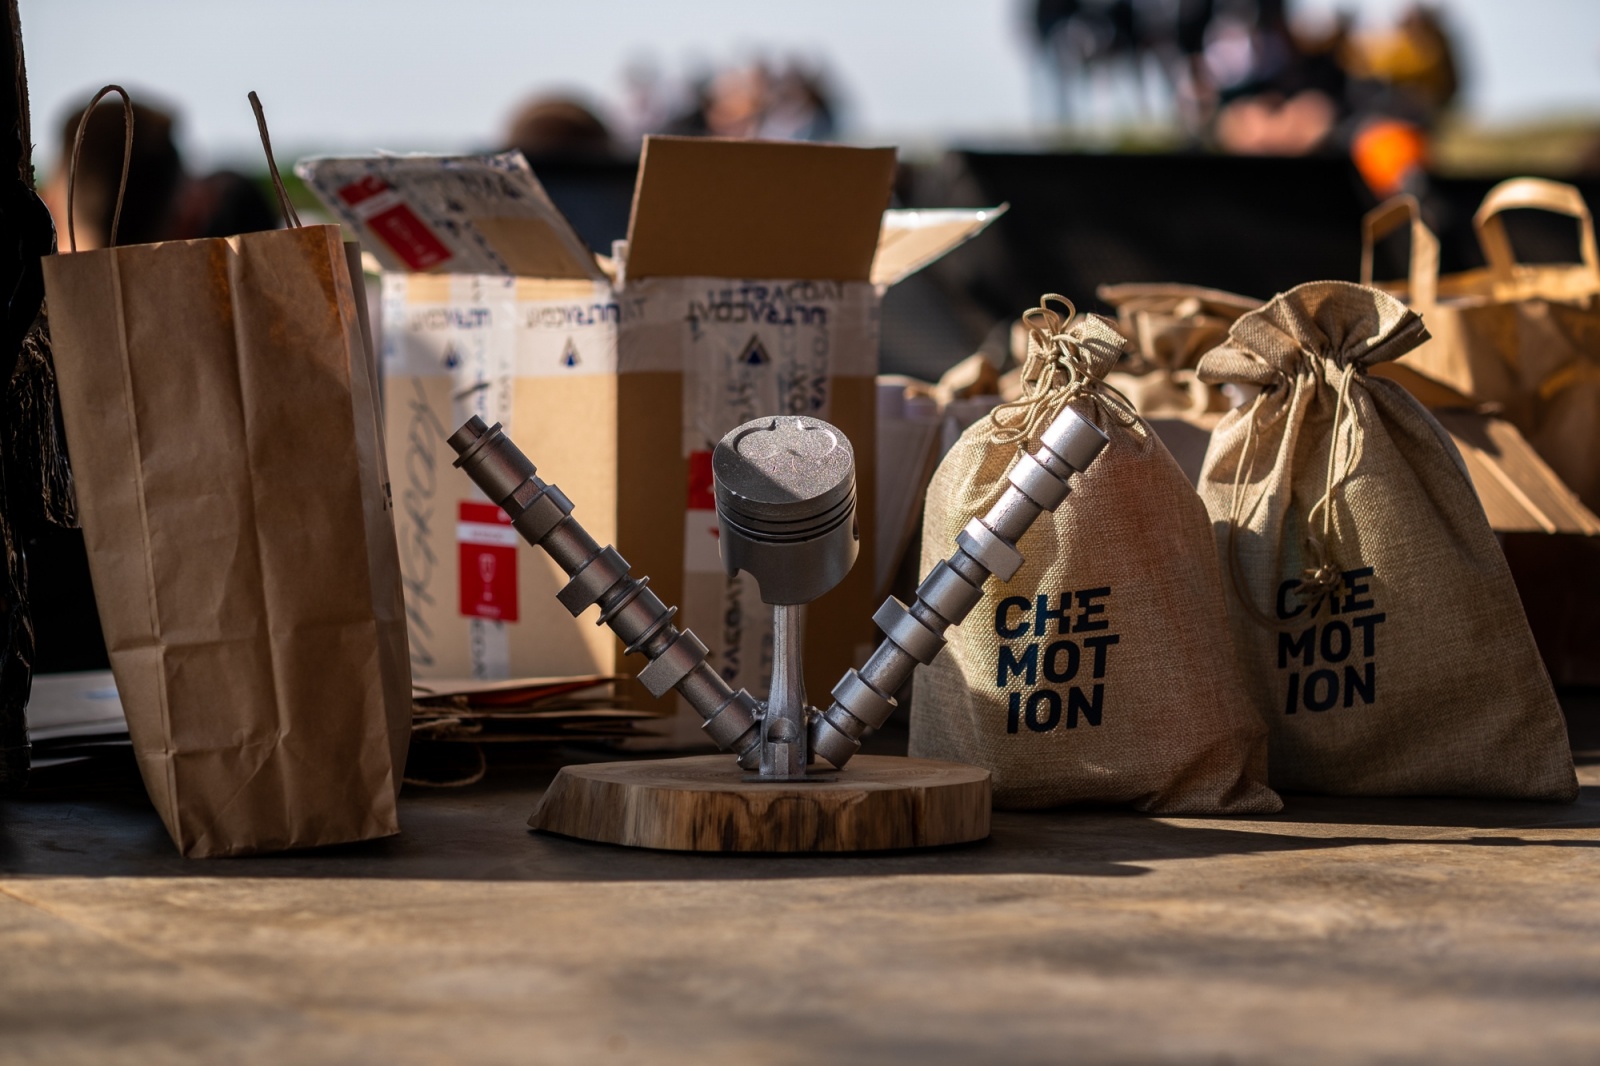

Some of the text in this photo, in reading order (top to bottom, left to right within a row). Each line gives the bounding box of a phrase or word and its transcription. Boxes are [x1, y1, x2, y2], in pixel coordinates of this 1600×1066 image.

[995, 586, 1111, 640] CHE
[996, 634, 1120, 688] MOT
[1278, 612, 1386, 669] MOT
[1007, 683, 1105, 734] ION
[1285, 662, 1375, 715] ION
